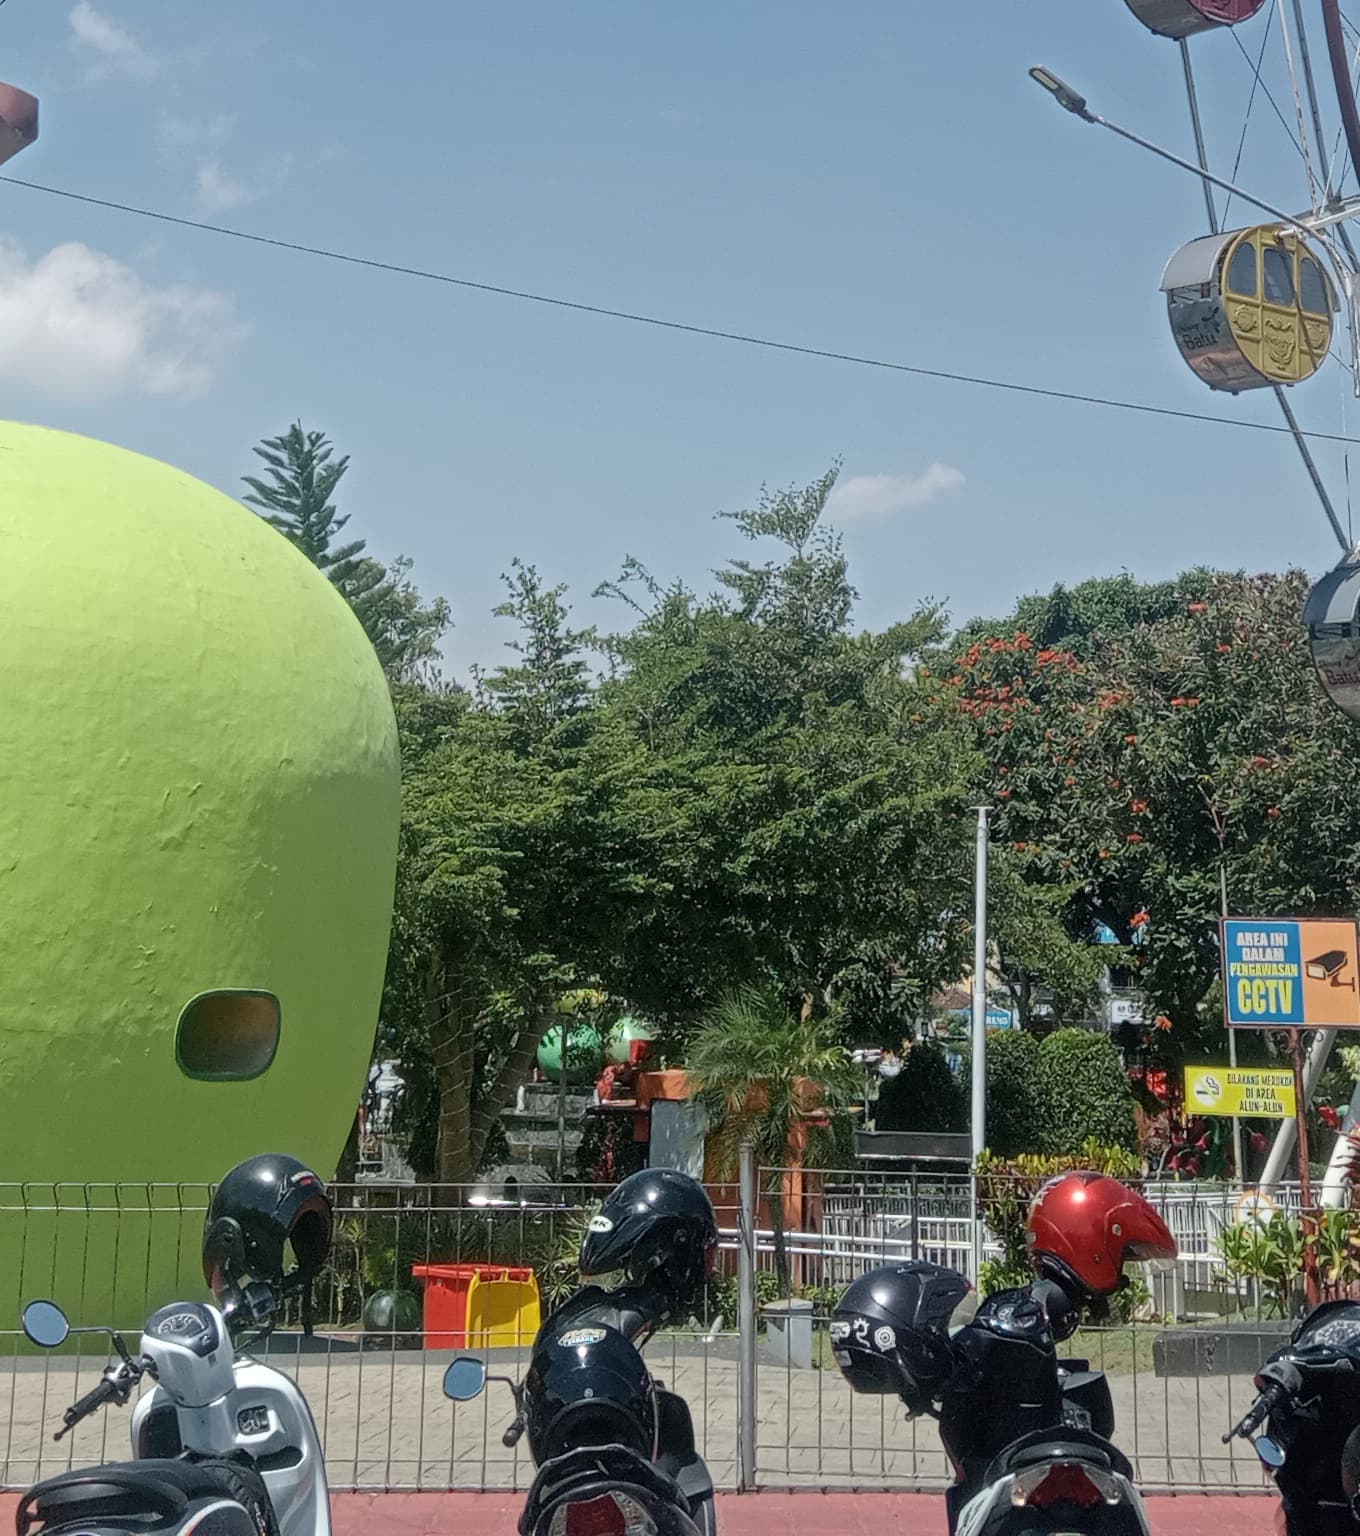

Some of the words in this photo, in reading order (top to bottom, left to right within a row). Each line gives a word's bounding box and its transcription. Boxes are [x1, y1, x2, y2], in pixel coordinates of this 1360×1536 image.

[1182, 333, 1217, 350] Batu
[1237, 932, 1268, 947] AREA
[1269, 932, 1288, 947] INI
[1242, 947, 1284, 962] DALAM
[1229, 962, 1298, 977] PENGAWASAN
[1237, 978, 1293, 1015] CCTV
[1245, 1087, 1254, 1098] DI
[1256, 1088, 1276, 1100] AREA
[1239, 1099, 1283, 1112] ALUN-ALUN
